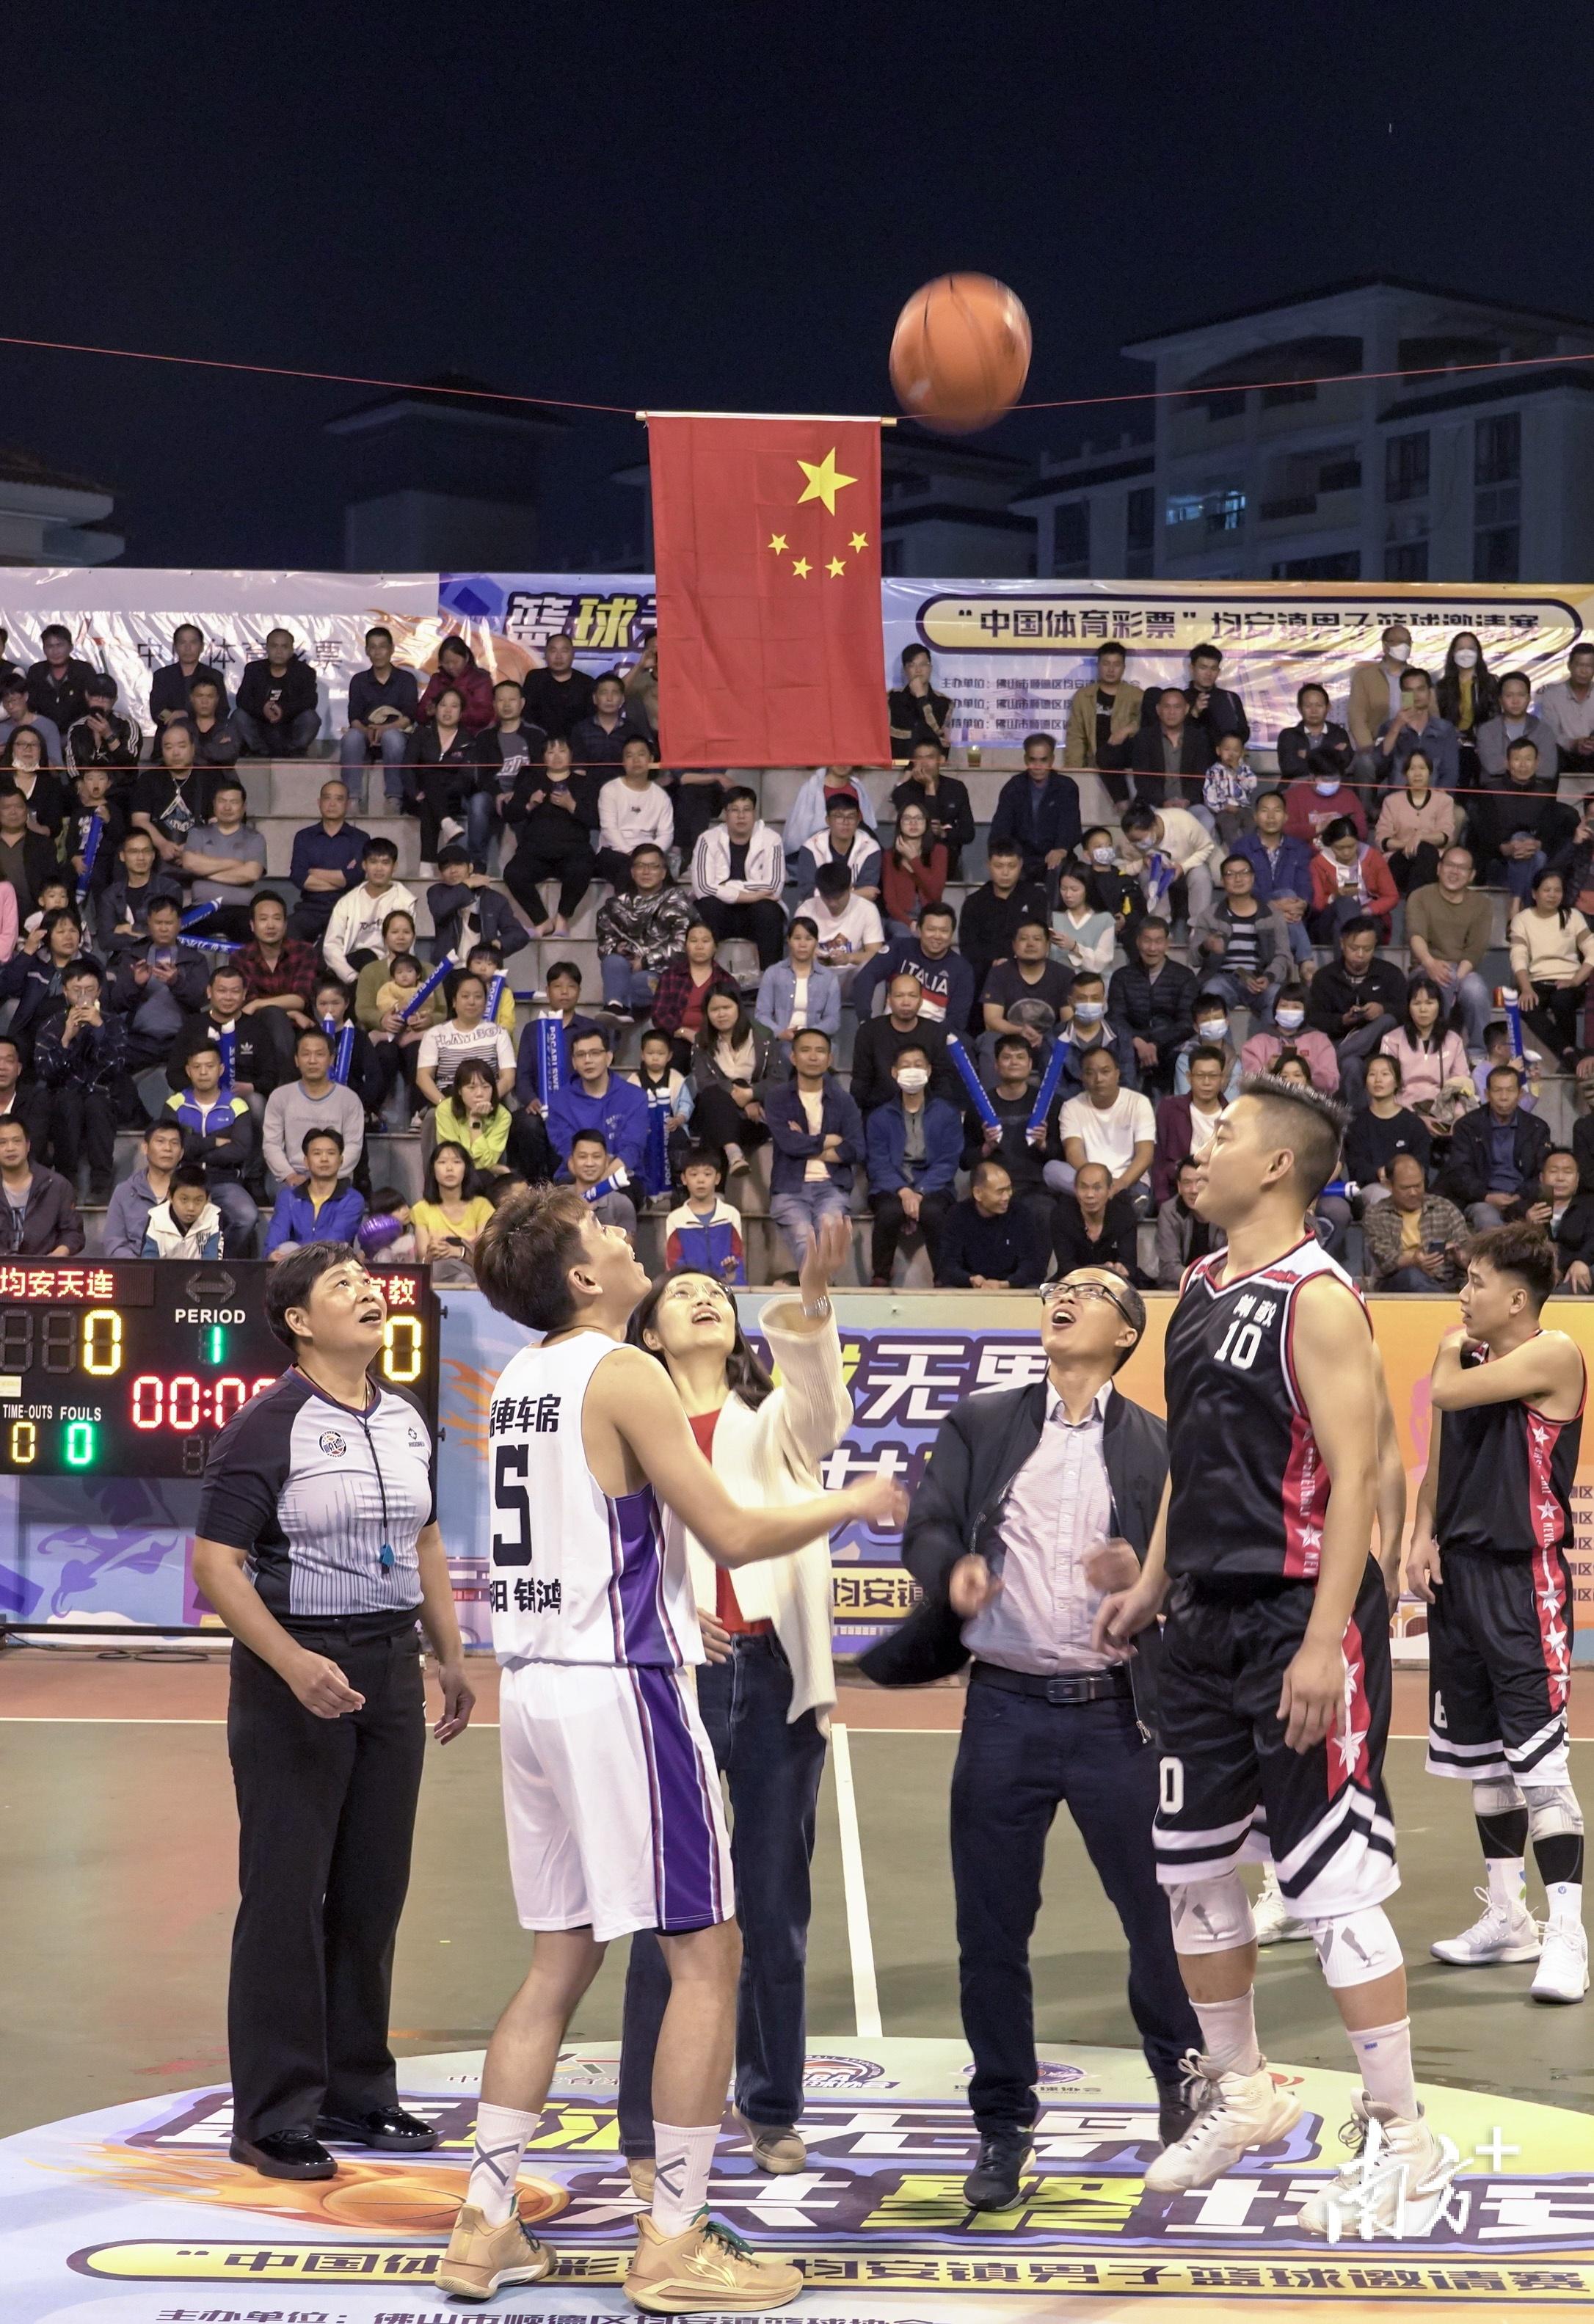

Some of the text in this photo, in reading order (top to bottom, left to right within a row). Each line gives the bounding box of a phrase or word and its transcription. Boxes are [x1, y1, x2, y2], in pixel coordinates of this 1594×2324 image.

[137, 638, 343, 671] 中体育票
[434, 1028, 502, 1046] PLAYBO
[0, 1267, 113, 1298] 均安天连
[175, 1309, 246, 1324] PERIOD
[84, 1309, 122, 1375] 0
[212, 1325, 222, 1364] 1
[384, 1316, 422, 1381] 0
[1212, 1319, 1263, 1372] 10
[3, 1405, 54, 1419] TIME-OUTS
[60, 1406, 102, 1422] FOULS
[12, 1421, 36, 1463] 0
[68, 1422, 92, 1465] 0
[492, 1443, 532, 1567] 5
